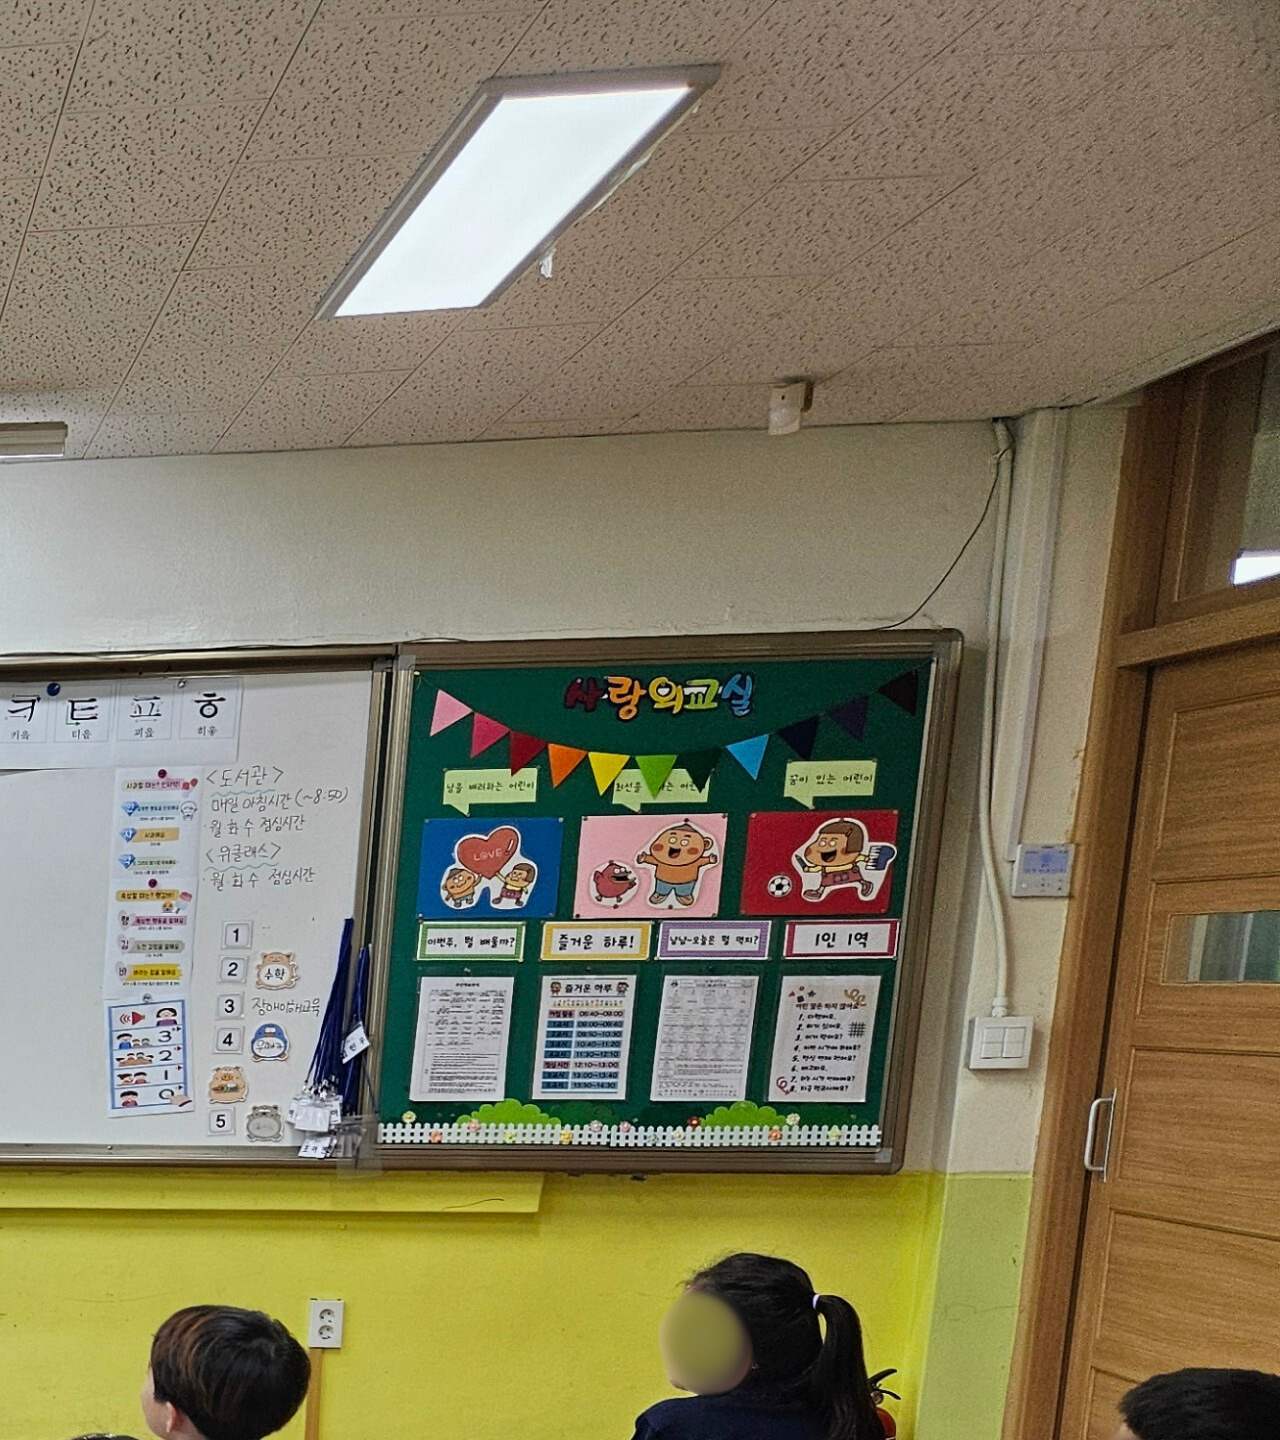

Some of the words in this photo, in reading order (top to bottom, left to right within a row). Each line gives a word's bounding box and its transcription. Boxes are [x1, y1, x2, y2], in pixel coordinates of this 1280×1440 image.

[446, 781, 463, 794] 남을
[469, 781, 504, 792] 배려하는
[509, 779, 535, 791] 어린이
[789, 775, 809, 786] 꿈이
[816, 774, 837, 784] 있는
[843, 773, 874, 784] 어린이
[615, 782, 642, 793] 최선을
[211, 795, 238, 813] 매일
[243, 791, 291, 811] 아침시간
[227, 818, 239, 837] 화
[244, 818, 255, 838] 수
[259, 814, 306, 833] 점심시간
[473, 848, 502, 861] LOVE
[232, 871, 244, 888] 화
[247, 871, 259, 888] 수
[268, 870, 316, 886] 점심시간
[232, 927, 240, 943] 1
[558, 933, 594, 951] 즐거운
[603, 934, 635, 950] 하루!
[736, 934, 759, 945] 먹지?
[427, 936, 457, 948] 이번주,
[464, 936, 474, 949] 뭘
[480, 936, 516, 949] 배울까?
[227, 962, 238, 978] 2
[263, 967, 287, 981] 수학
[565, 984, 591, 993] 즐거운
[594, 984, 612, 993] 하루
[224, 998, 235, 1014] 3
[251, 997, 321, 1017] 장애이해교육
[222, 1033, 233, 1047] 4
[215, 1114, 226, 1128] 5
